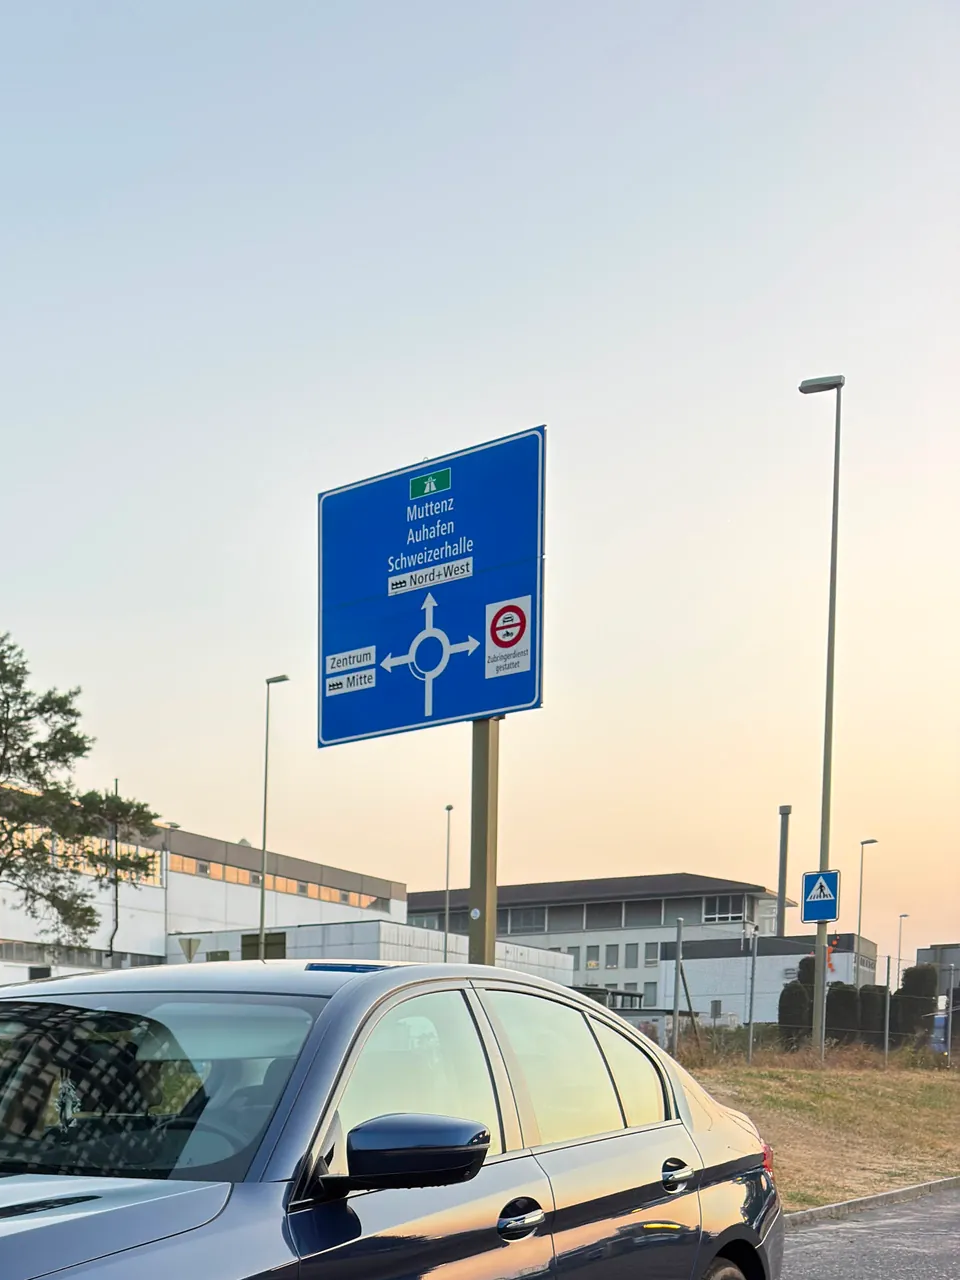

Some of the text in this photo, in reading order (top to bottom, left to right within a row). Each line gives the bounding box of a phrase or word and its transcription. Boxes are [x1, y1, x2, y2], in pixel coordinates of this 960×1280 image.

[406, 498, 454, 522] Muttenz
[406, 519, 455, 545] Auhafen
[387, 536, 474, 573] Schweizerhalle
[409, 561, 471, 587] Nord+West
[330, 652, 372, 669] Zentrum
[487, 649, 529, 664] Zubringerdienst
[495, 661, 520, 674] gestattet
[346, 674, 374, 689] Mitte
